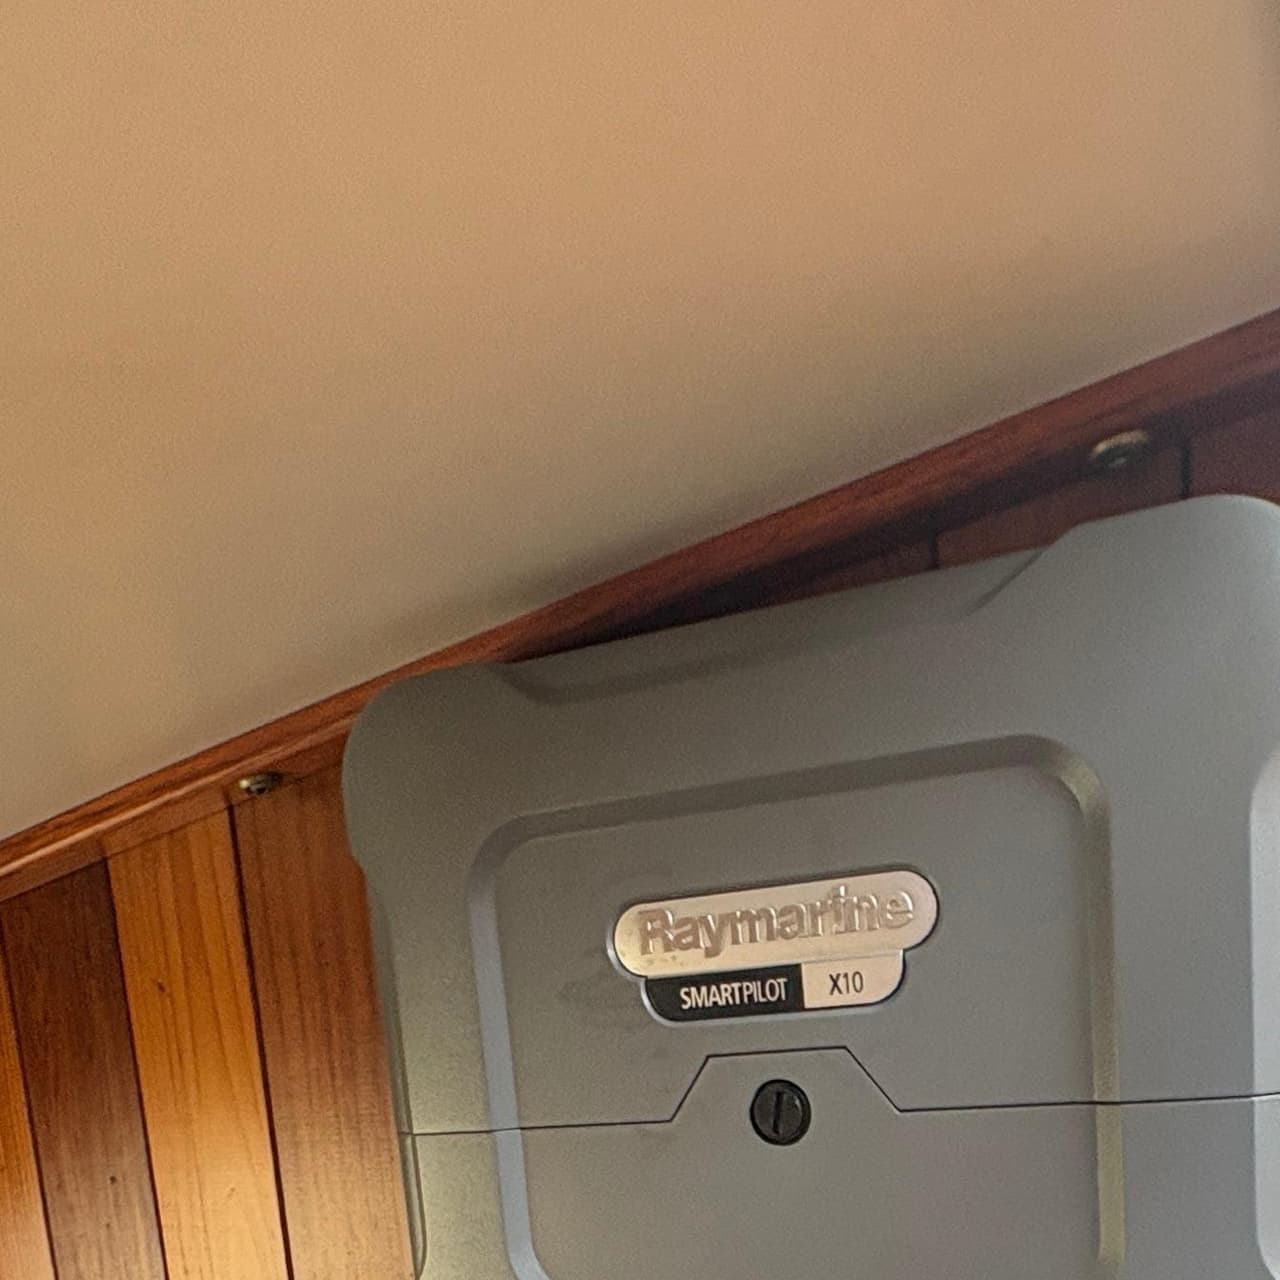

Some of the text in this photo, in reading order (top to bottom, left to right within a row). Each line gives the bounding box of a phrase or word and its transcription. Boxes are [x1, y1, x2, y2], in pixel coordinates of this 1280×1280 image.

[638, 885, 914, 960] Raymarine
[679, 971, 865, 1010] SMARTPILOT X10
